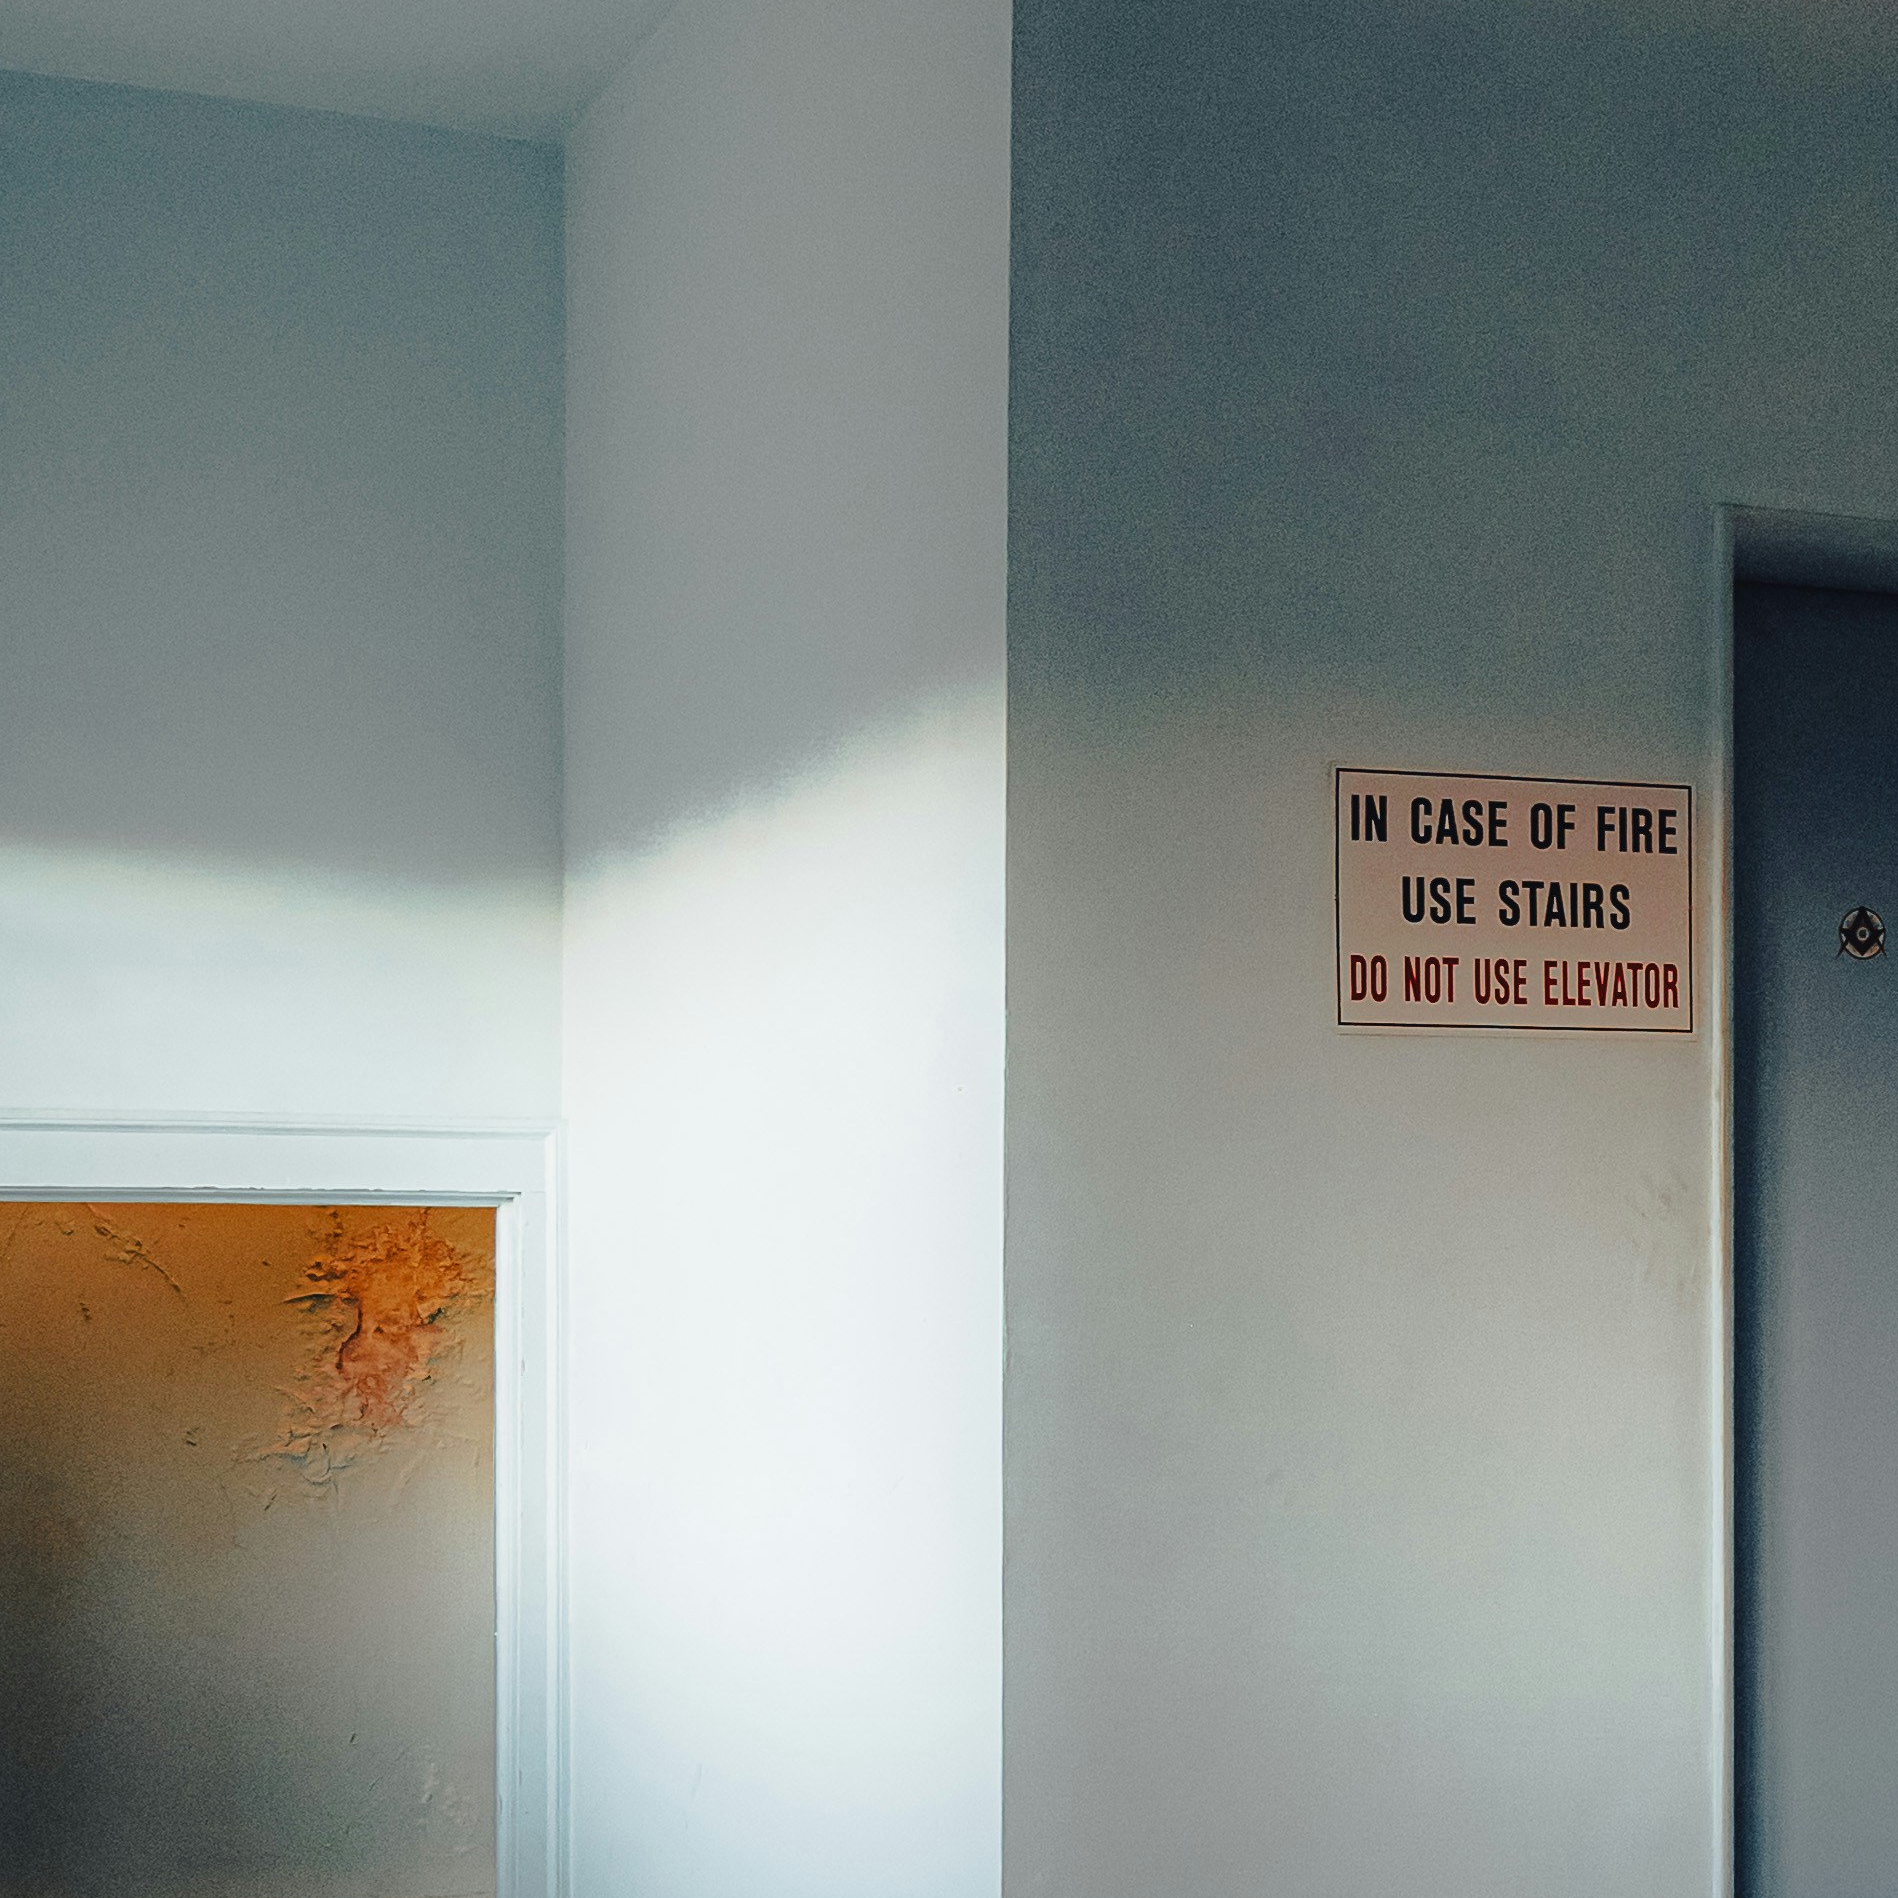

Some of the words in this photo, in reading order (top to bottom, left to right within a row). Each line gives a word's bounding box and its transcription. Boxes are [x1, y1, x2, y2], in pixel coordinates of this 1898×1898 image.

[1350, 794, 1389, 843] IN
[1410, 796, 1509, 848] CASE
[1529, 802, 1577, 850] OF
[1596, 805, 1678, 855] FIRE
[1401, 875, 1477, 925] USE
[1498, 879, 1631, 930] STAIRS
[1349, 954, 1389, 1003] DO
[1403, 955, 1460, 1004] NOT
[1474, 957, 1528, 1006] USE
[1543, 960, 1680, 1009] ELEVATOR
